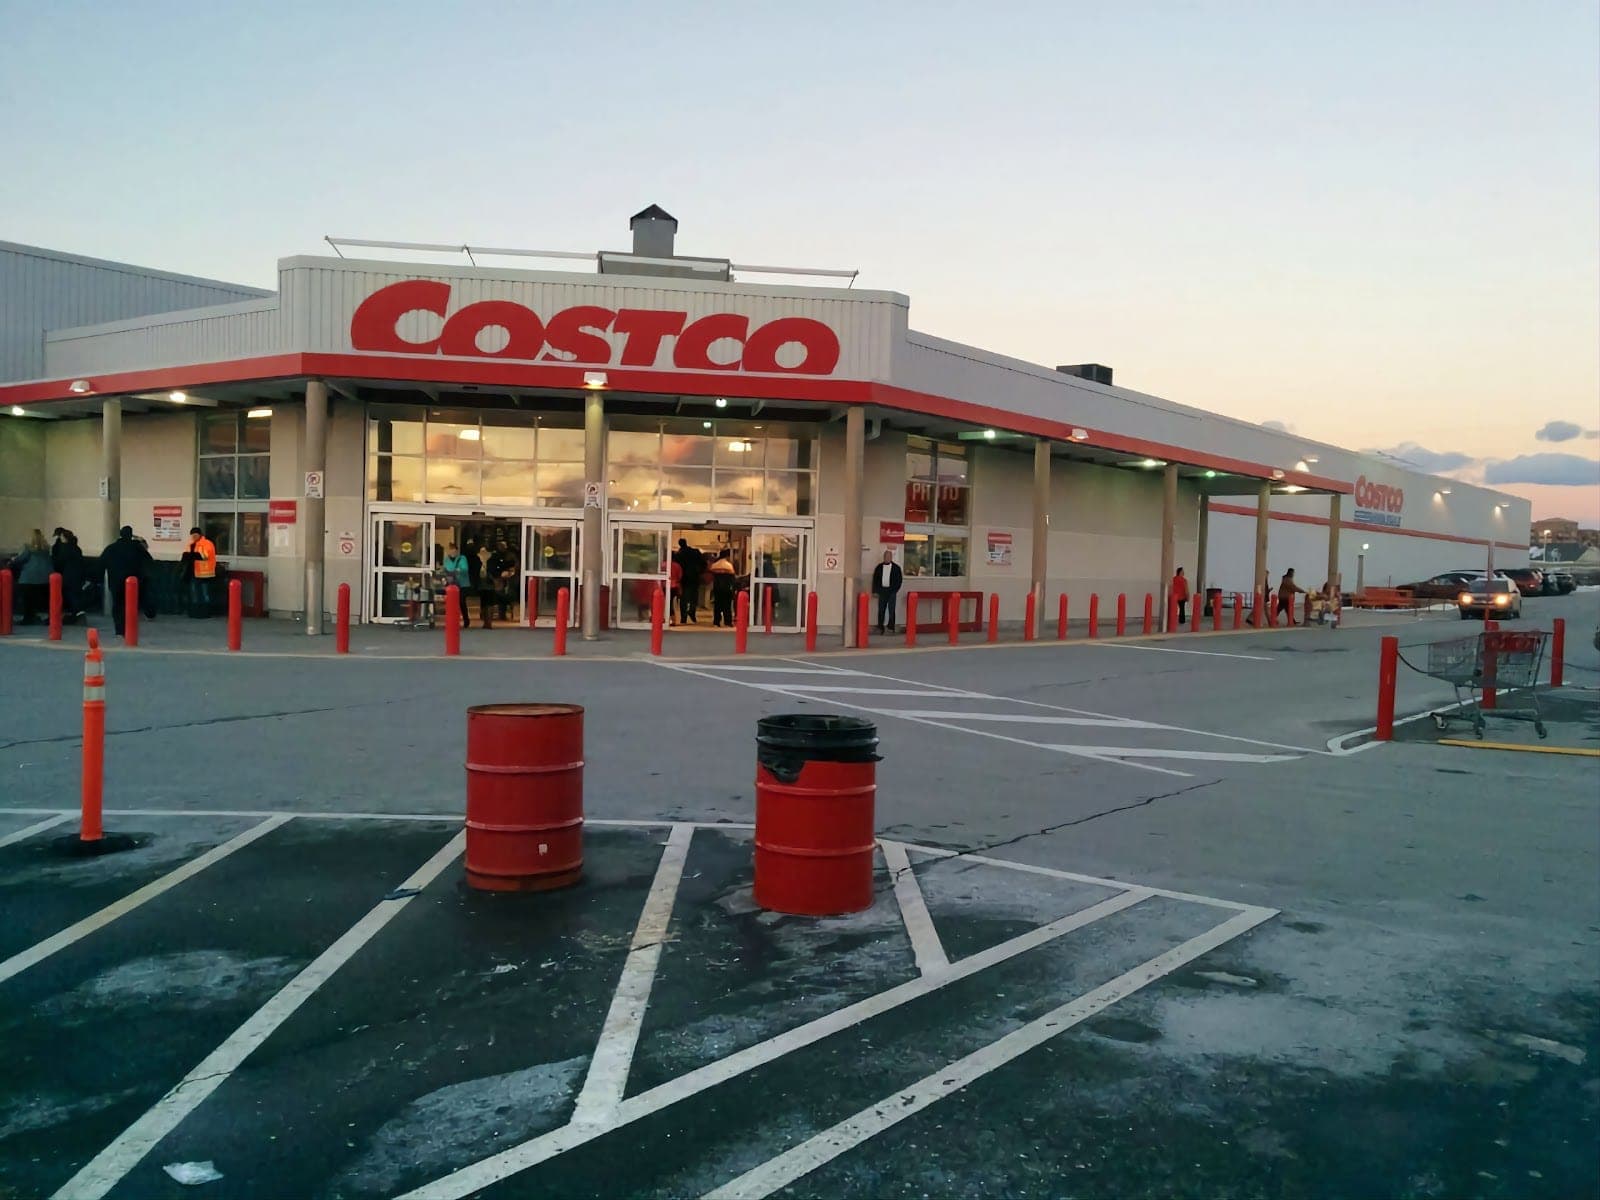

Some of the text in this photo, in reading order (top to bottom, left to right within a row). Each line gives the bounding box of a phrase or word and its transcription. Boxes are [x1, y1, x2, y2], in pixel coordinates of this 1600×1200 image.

[351, 279, 839, 375] COSTCO
[912, 482, 960, 501] PHTO
[1354, 474, 1404, 513] COSTCO
